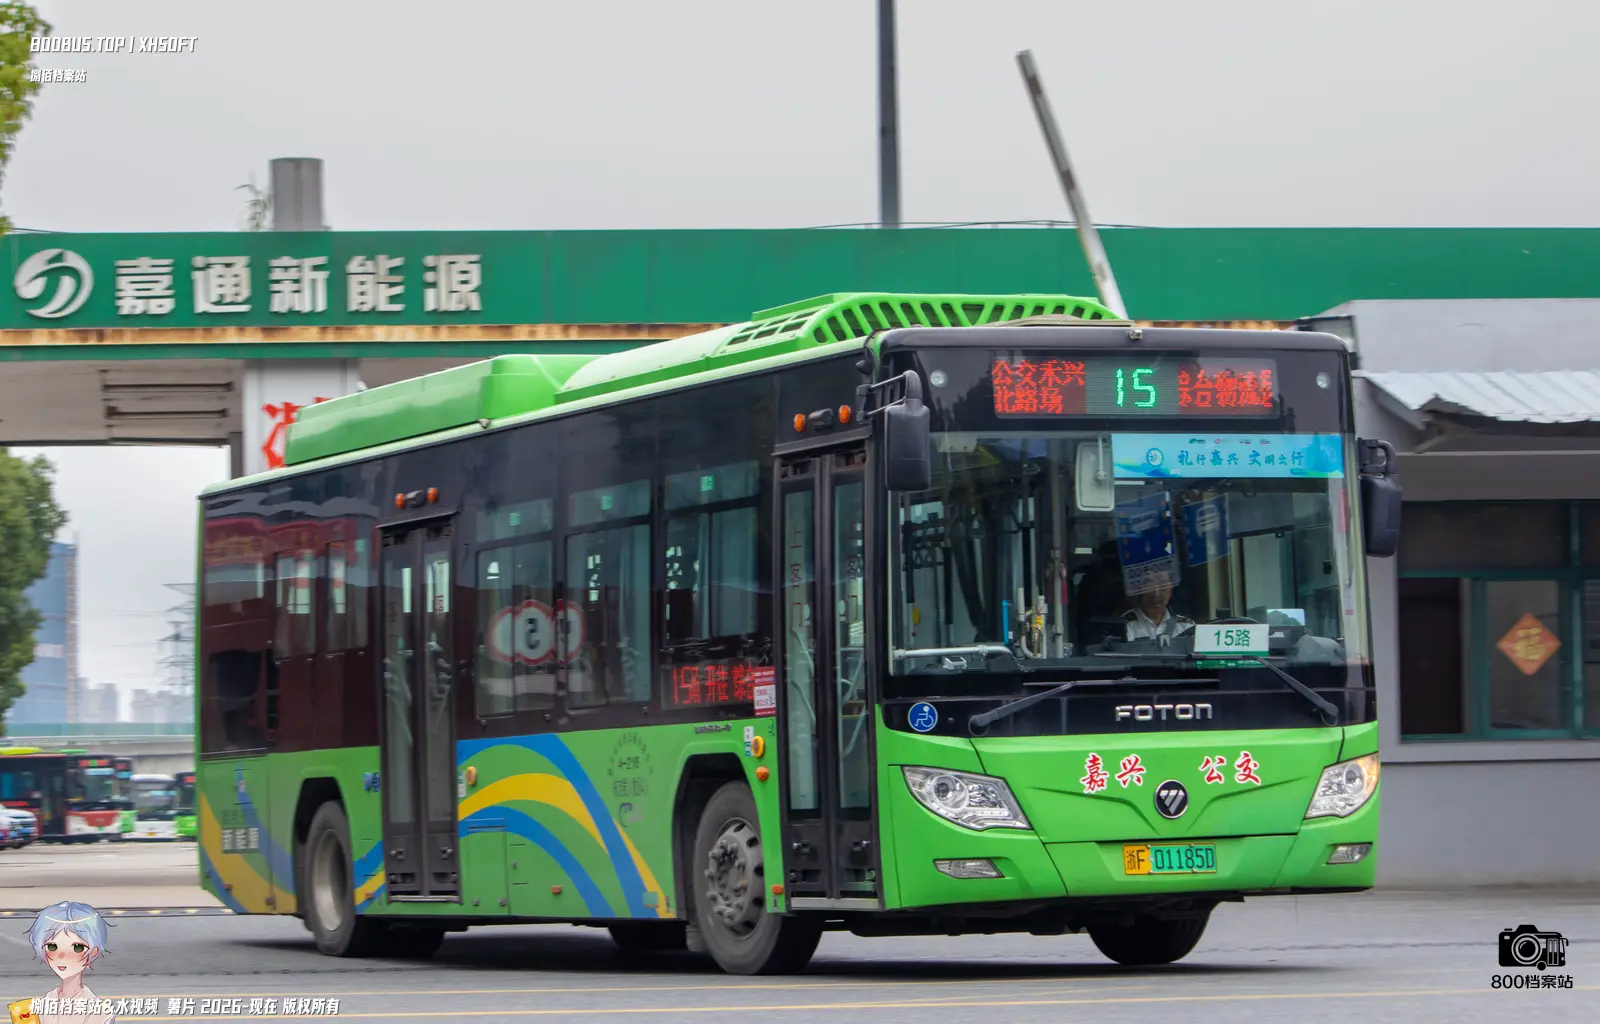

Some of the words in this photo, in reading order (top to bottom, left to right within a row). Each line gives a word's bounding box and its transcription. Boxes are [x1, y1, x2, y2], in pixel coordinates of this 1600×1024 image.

[114, 254, 482, 316] 嘉通新能源
[1115, 368, 1156, 407] 15
[1214, 629, 1251, 647] 15路
[1115, 703, 1213, 722] FOTON
[1081, 753, 1147, 792] 嘉兴
[1199, 751, 1263, 786] 公交
[1154, 847, 1215, 870] 01185D
